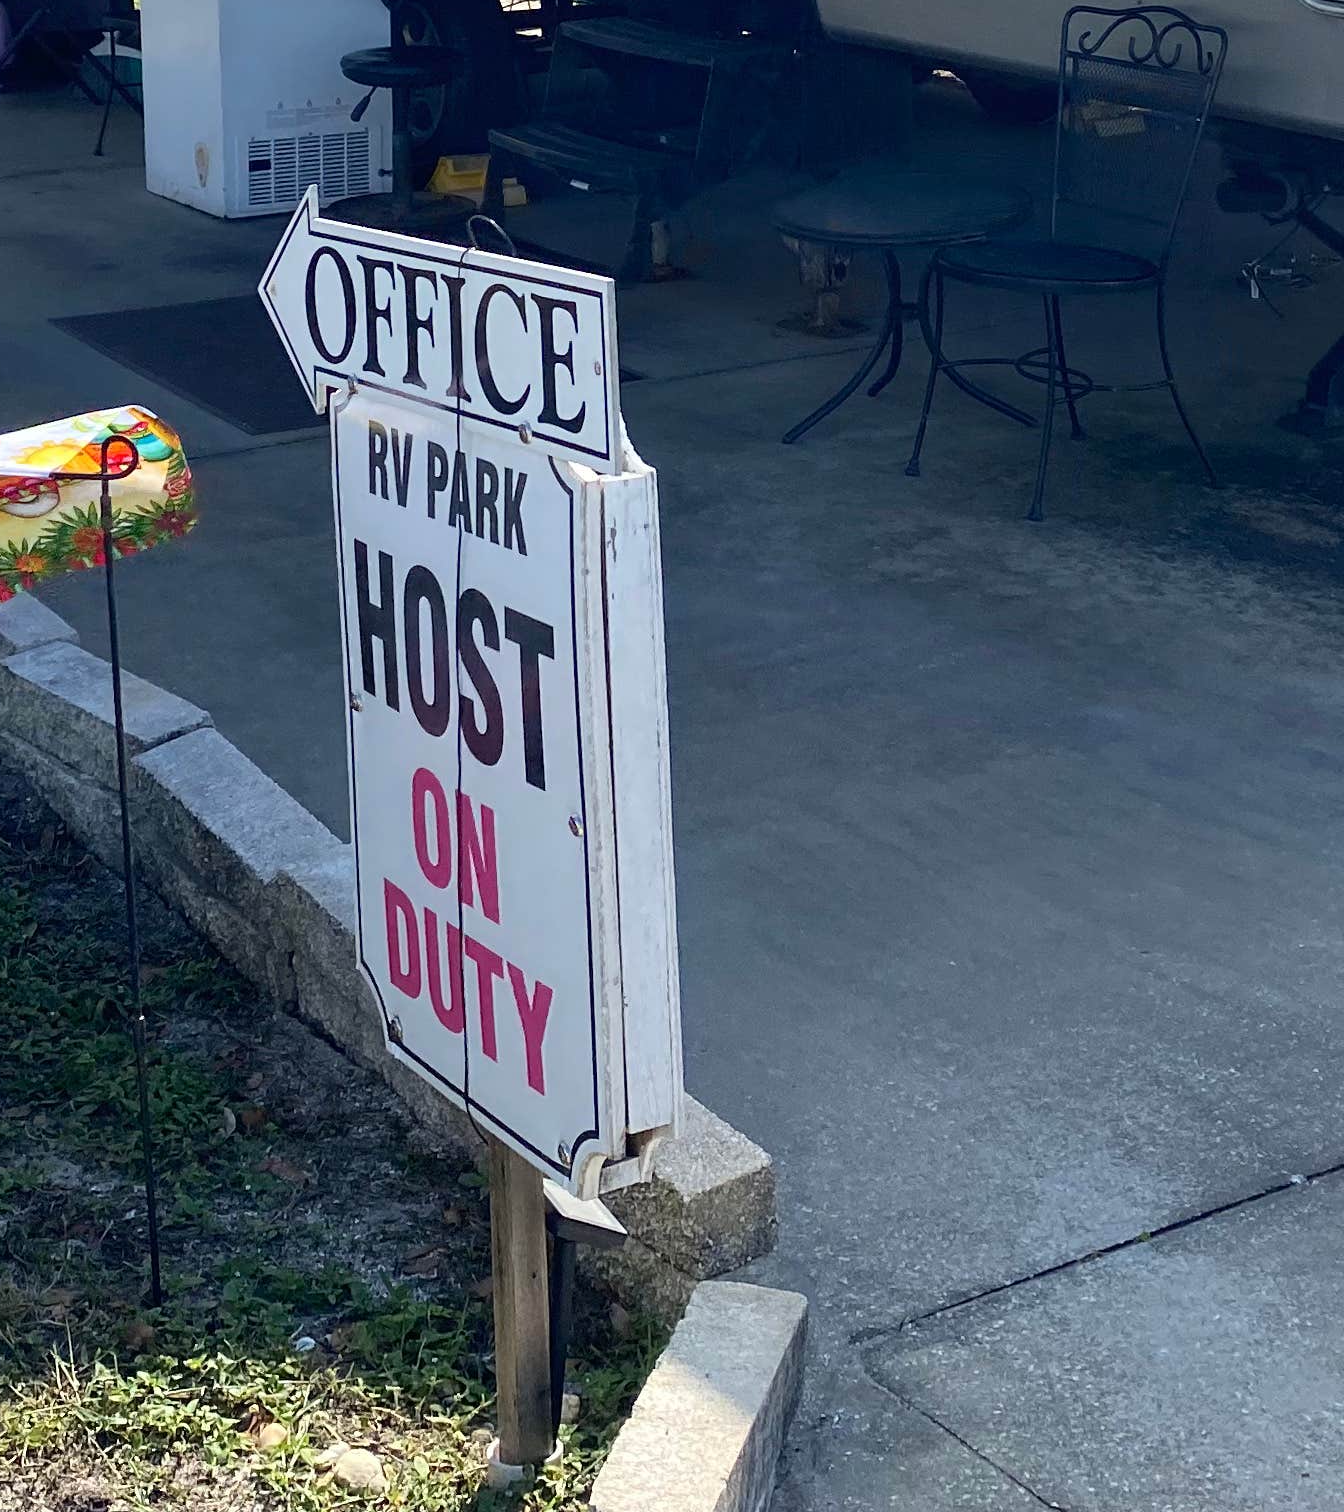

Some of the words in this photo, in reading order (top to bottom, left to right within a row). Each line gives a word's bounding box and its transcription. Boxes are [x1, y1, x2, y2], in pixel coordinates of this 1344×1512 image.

[305, 245, 587, 434] OFFICE
[368, 419, 414, 508] RV
[426, 440, 528, 556] PARK
[353, 537, 555, 792] HOST
[412, 767, 501, 925] ON
[383, 877, 554, 1096] DUTY
